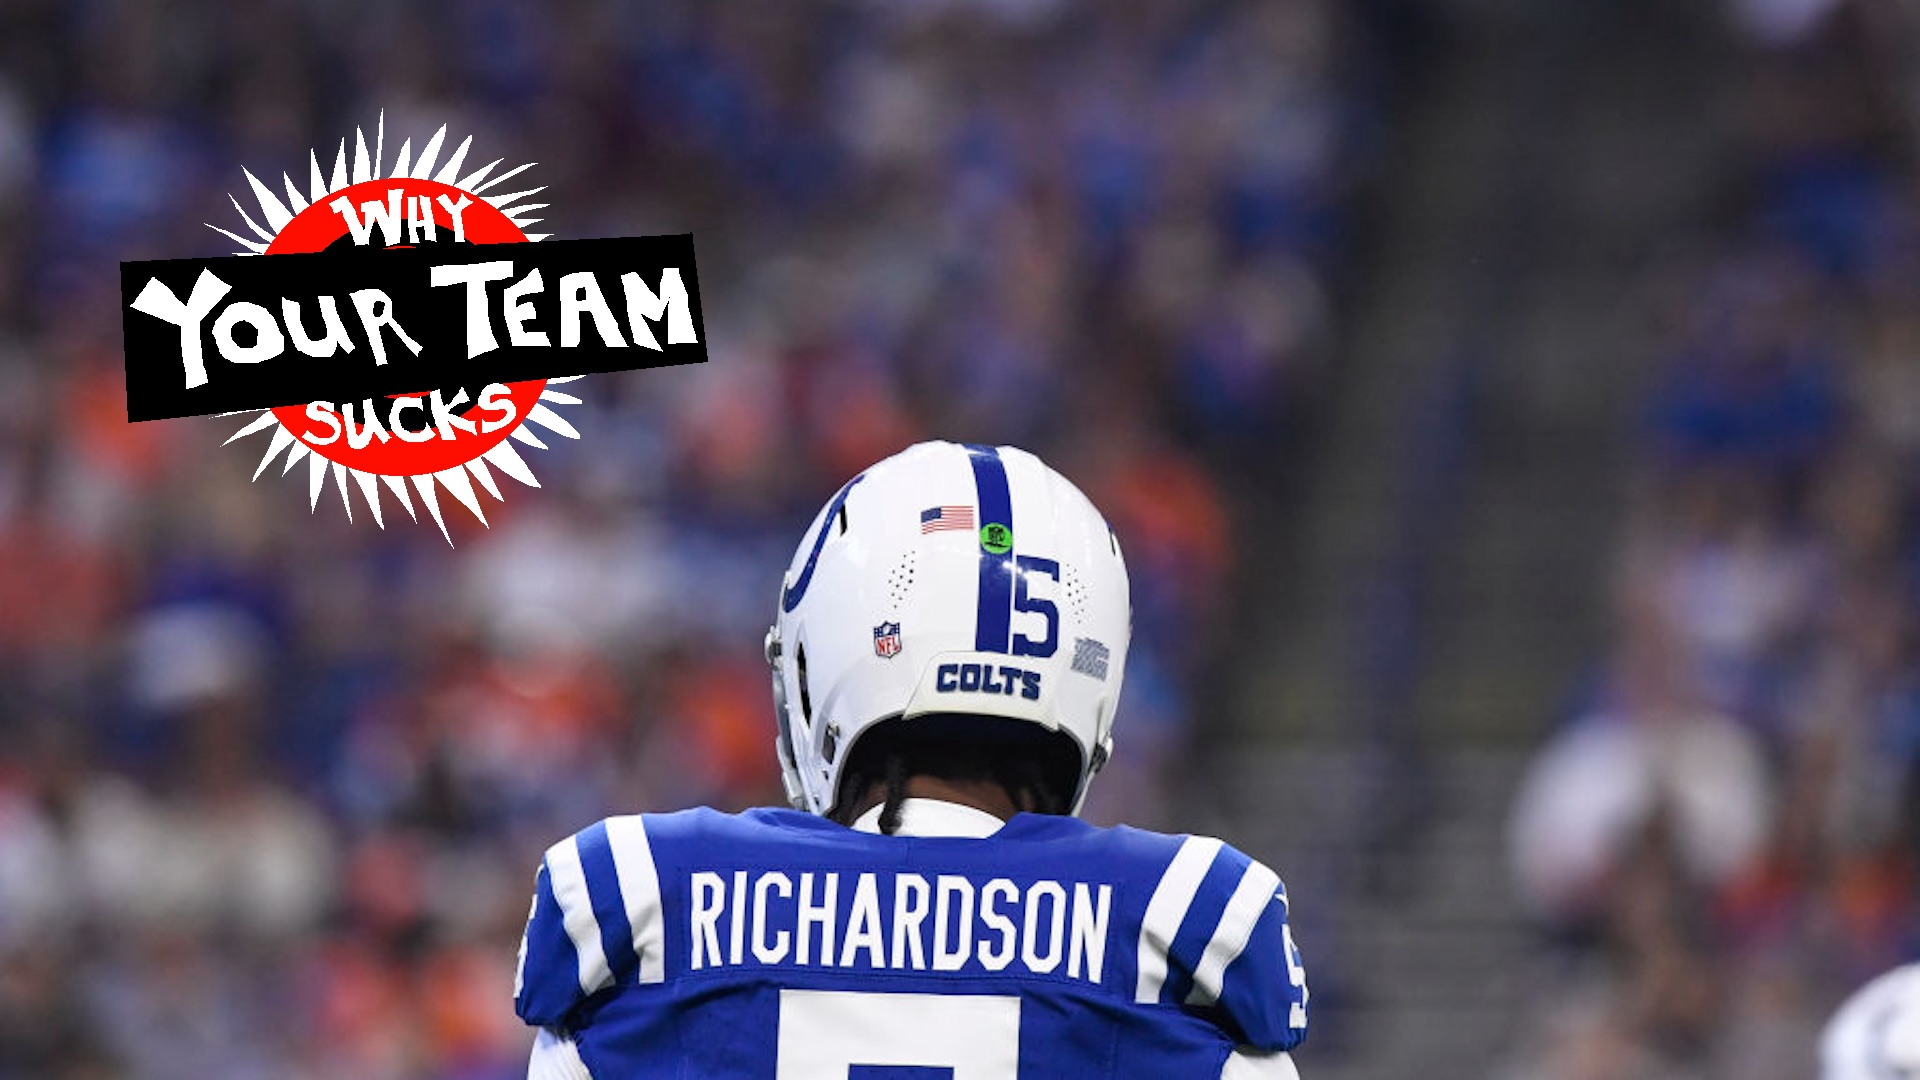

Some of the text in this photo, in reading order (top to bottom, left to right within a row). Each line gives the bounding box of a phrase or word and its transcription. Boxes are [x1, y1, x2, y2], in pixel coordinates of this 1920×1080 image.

[1012, 554, 1060, 658] 5
[877, 636, 900, 655] NFL
[936, 663, 1042, 701] COLTS
[690, 871, 1112, 984] RICHARDSON
